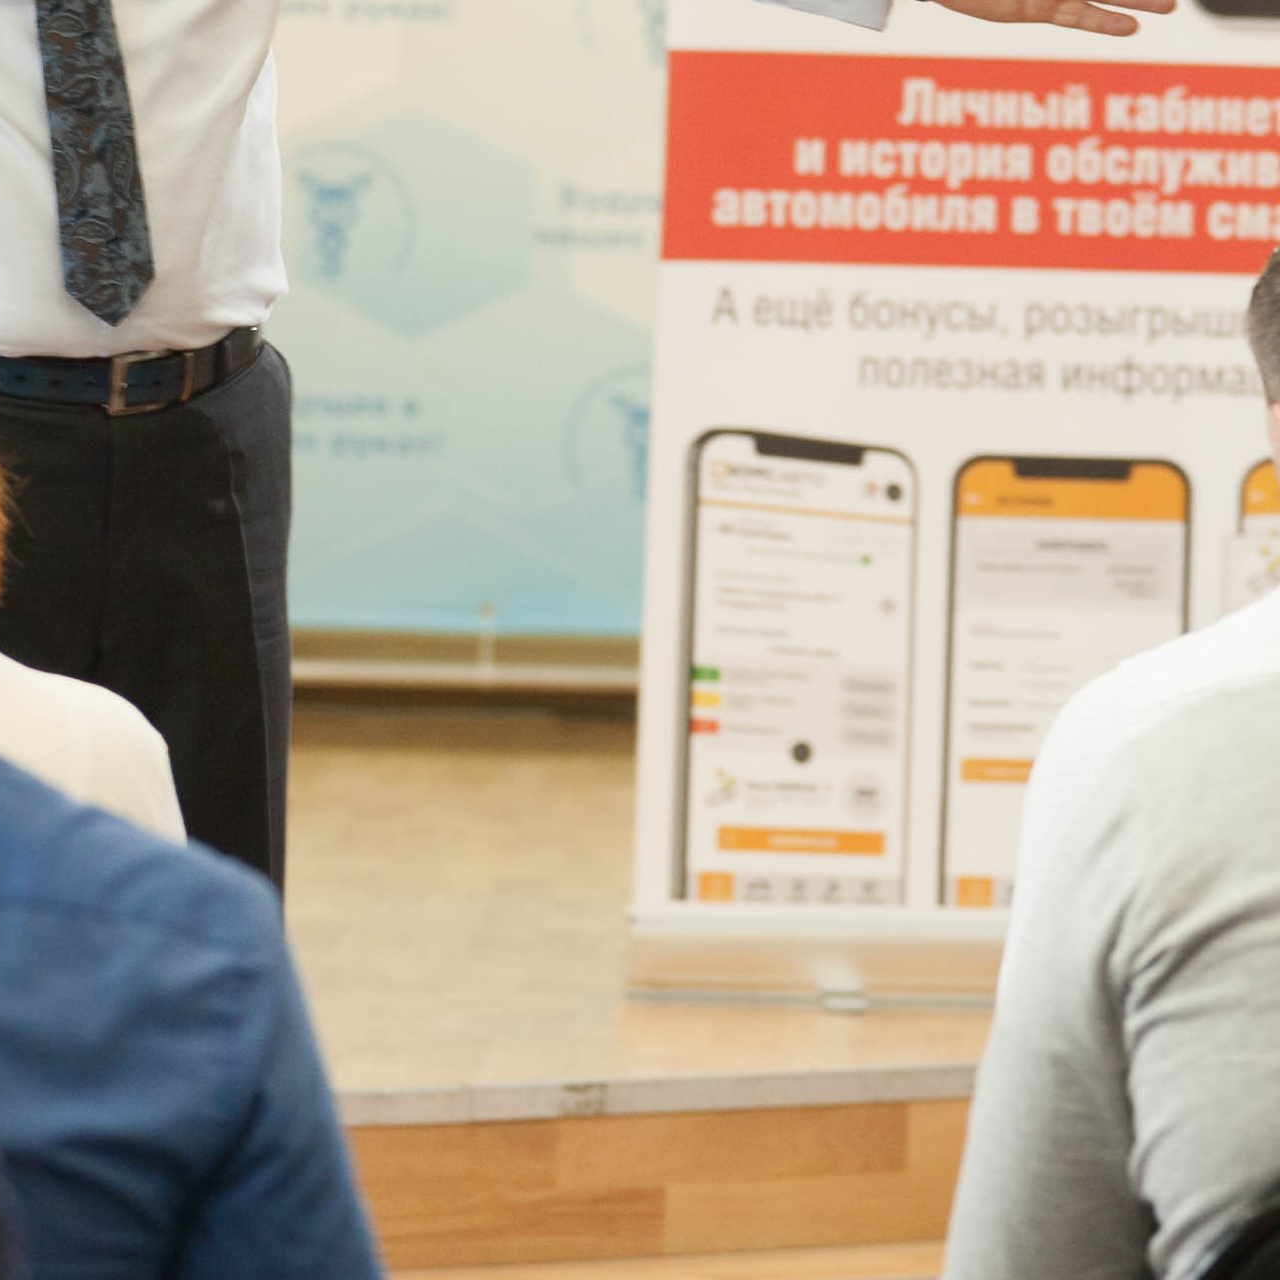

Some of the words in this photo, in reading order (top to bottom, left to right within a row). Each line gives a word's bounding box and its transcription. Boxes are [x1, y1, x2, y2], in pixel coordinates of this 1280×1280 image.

[897, 77, 1090, 131] Личный
[795, 139, 824, 176] и
[840, 141, 1031, 188] история
[712, 186, 996, 235] автомобиля
[1012, 196, 1040, 235] в
[1055, 190, 1193, 240] твоём
[712, 287, 737, 326] А
[752, 289, 832, 334] ещё
[848, 289, 1010, 340] бонусы,
[860, 354, 1042, 391] полезная
